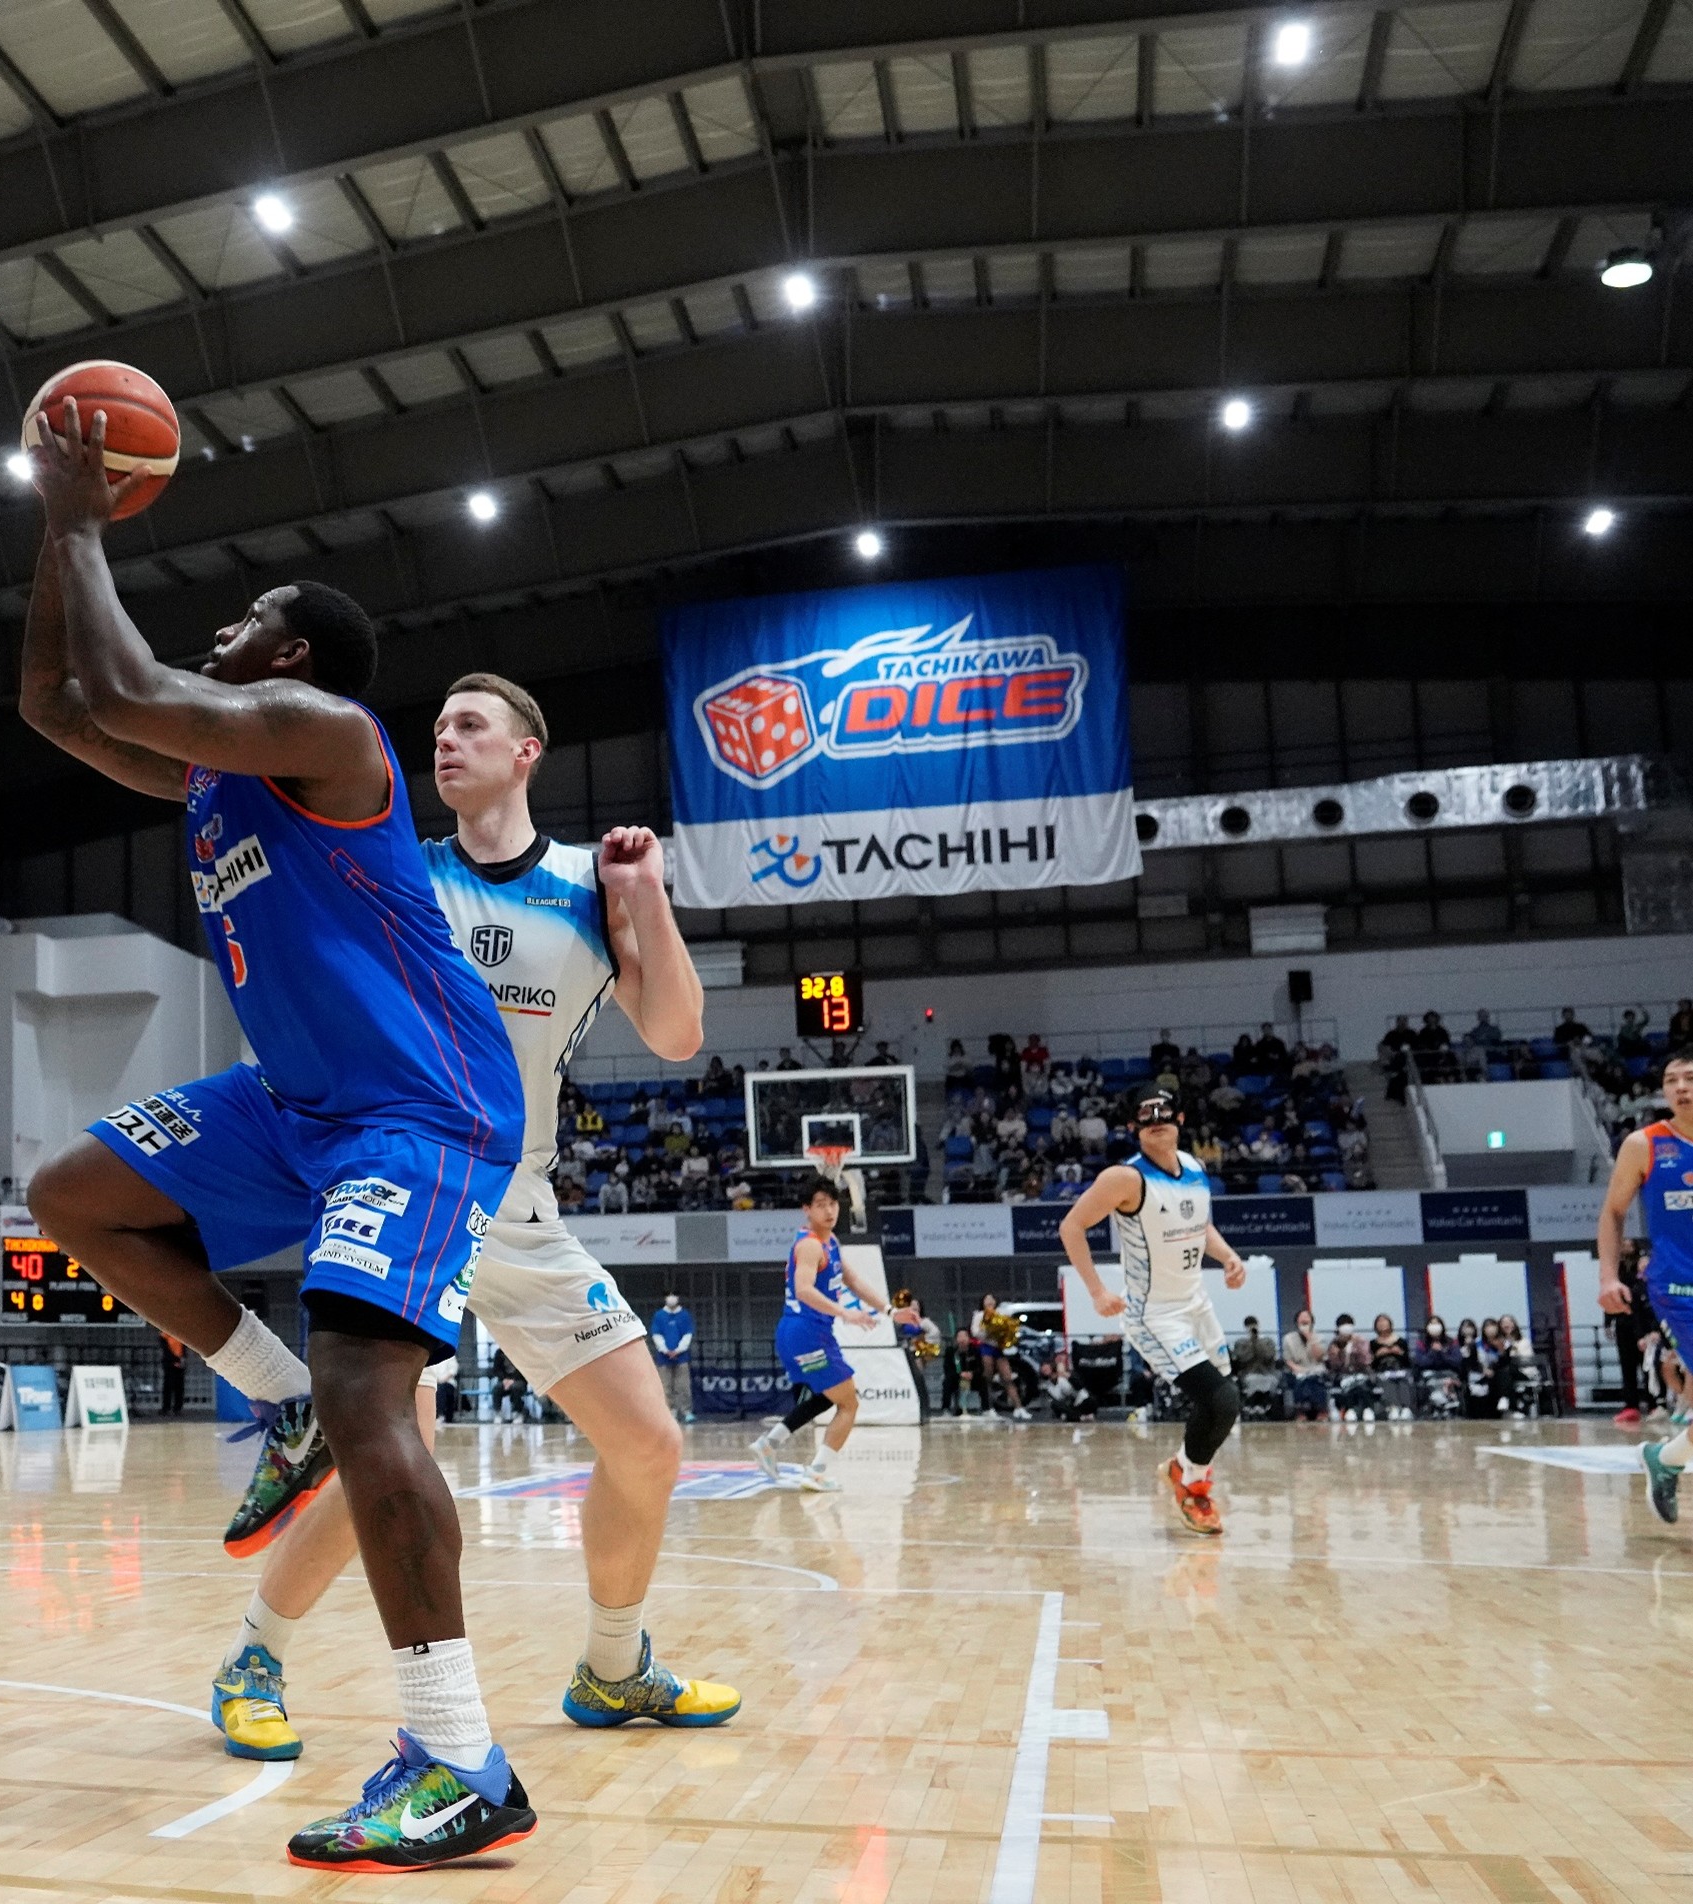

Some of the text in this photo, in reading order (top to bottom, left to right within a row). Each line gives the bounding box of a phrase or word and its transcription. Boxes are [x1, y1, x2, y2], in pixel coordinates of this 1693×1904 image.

[881, 646, 1047, 681] TACHIKAWA
[845, 668, 1076, 734] DICE
[822, 824, 1057, 877] TACHIHI
[801, 975, 845, 1000] 32.8
[822, 996, 850, 1031] 13
[11, 1254, 44, 1281] 40
[1183, 1247, 1200, 1271] 33
[10, 1291, 25, 1310] 4
[574, 1318, 613, 1343] Neural
[702, 1375, 794, 1393] VOLVO
